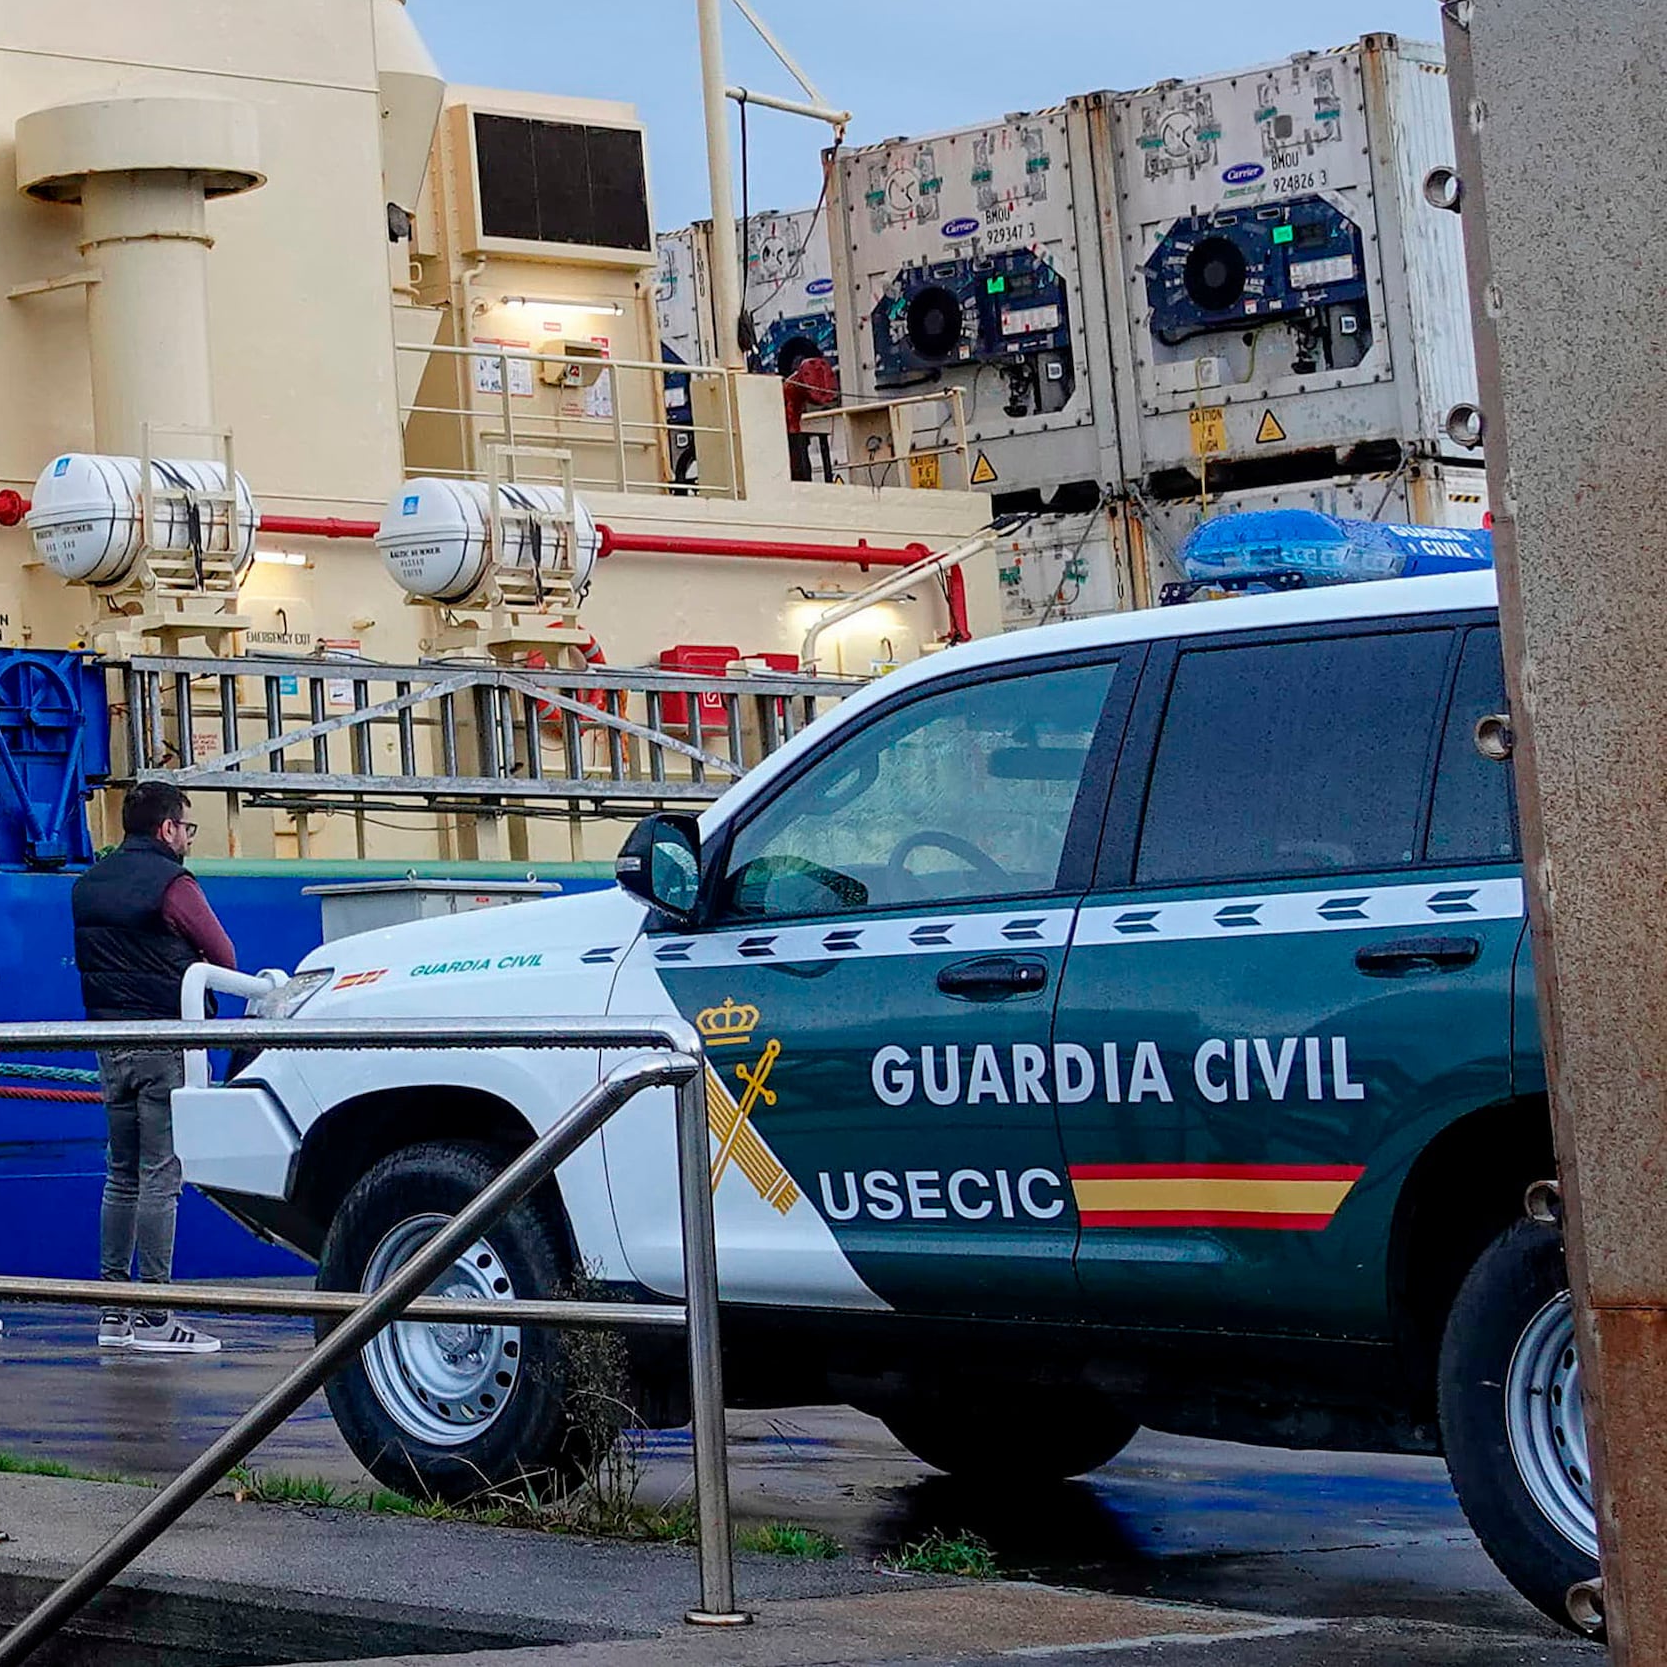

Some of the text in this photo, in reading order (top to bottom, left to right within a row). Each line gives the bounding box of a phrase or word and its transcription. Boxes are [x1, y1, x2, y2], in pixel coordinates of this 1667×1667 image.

[1271, 152, 1299, 170] BMOU
[1226, 166, 1261, 181] Carrier
[1273, 173, 1314, 194] 924826
[1320, 170, 1327, 185] 3
[985, 207, 1011, 226] BMOU
[945, 220, 977, 235] Carrier
[987, 224, 1023, 245] 929347
[1029, 222, 1036, 237] 3
[1388, 524, 1472, 542] GUARDIA
[1419, 540, 1472, 559] CIVIL
[246, 631, 311, 646] EMERGENCY EXIT
[410, 953, 544, 977] GUARDIA CIVIL
[871, 1035, 1366, 1107] GUARDIA CIVIL
[818, 1167, 1066, 1221] USECIC
